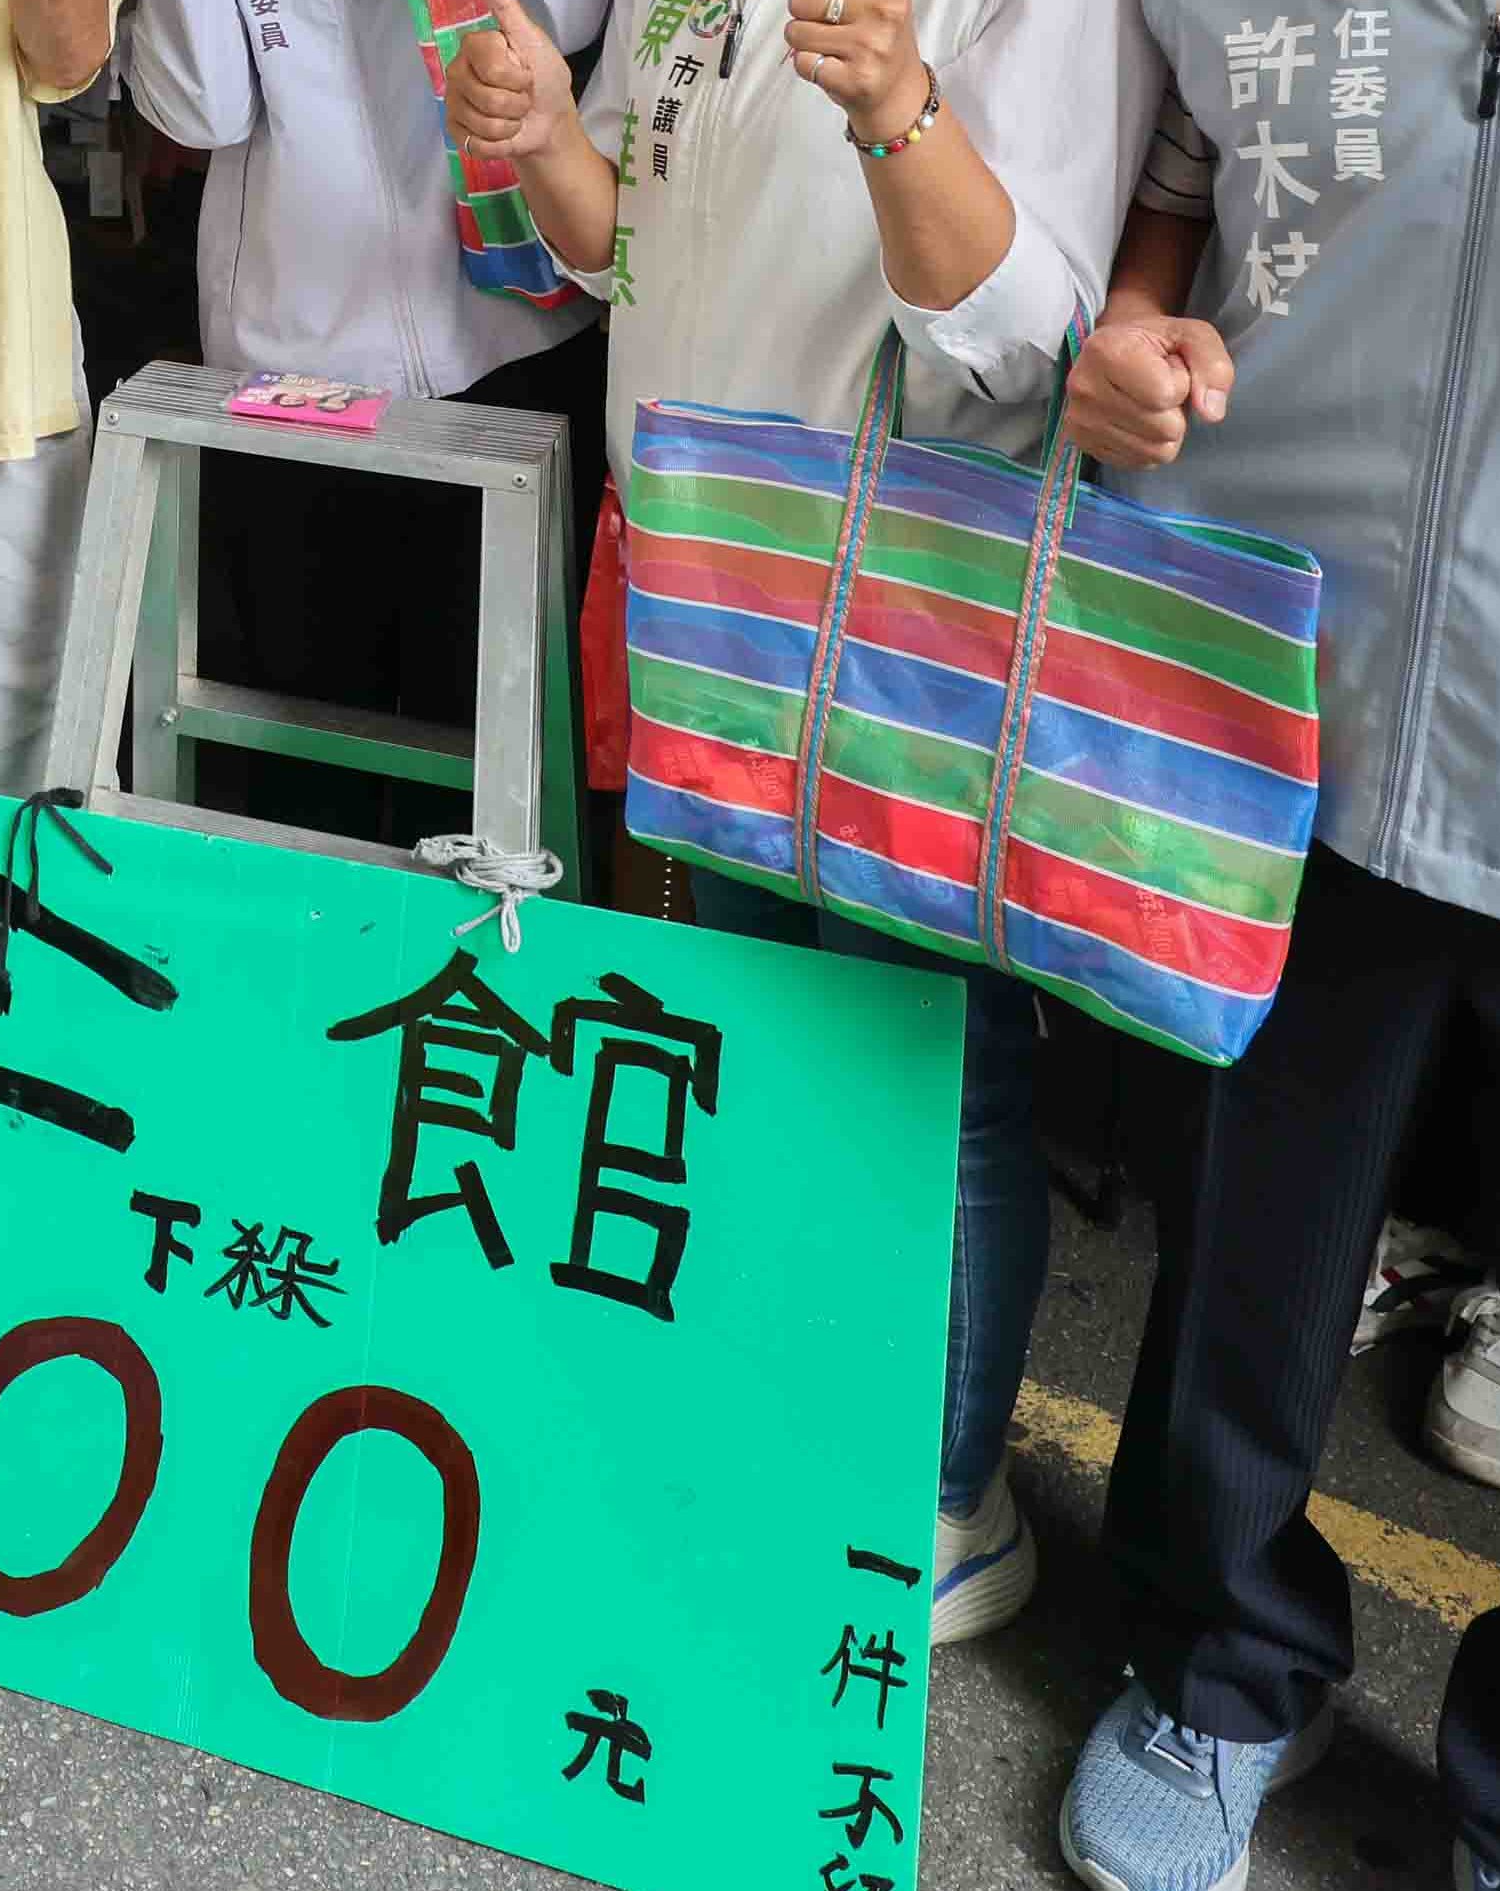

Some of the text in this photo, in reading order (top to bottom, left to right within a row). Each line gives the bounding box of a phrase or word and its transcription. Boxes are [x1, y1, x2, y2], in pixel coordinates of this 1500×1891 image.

[651, 53, 705, 182] 市議員
[561, 1689, 653, 1805] 元
